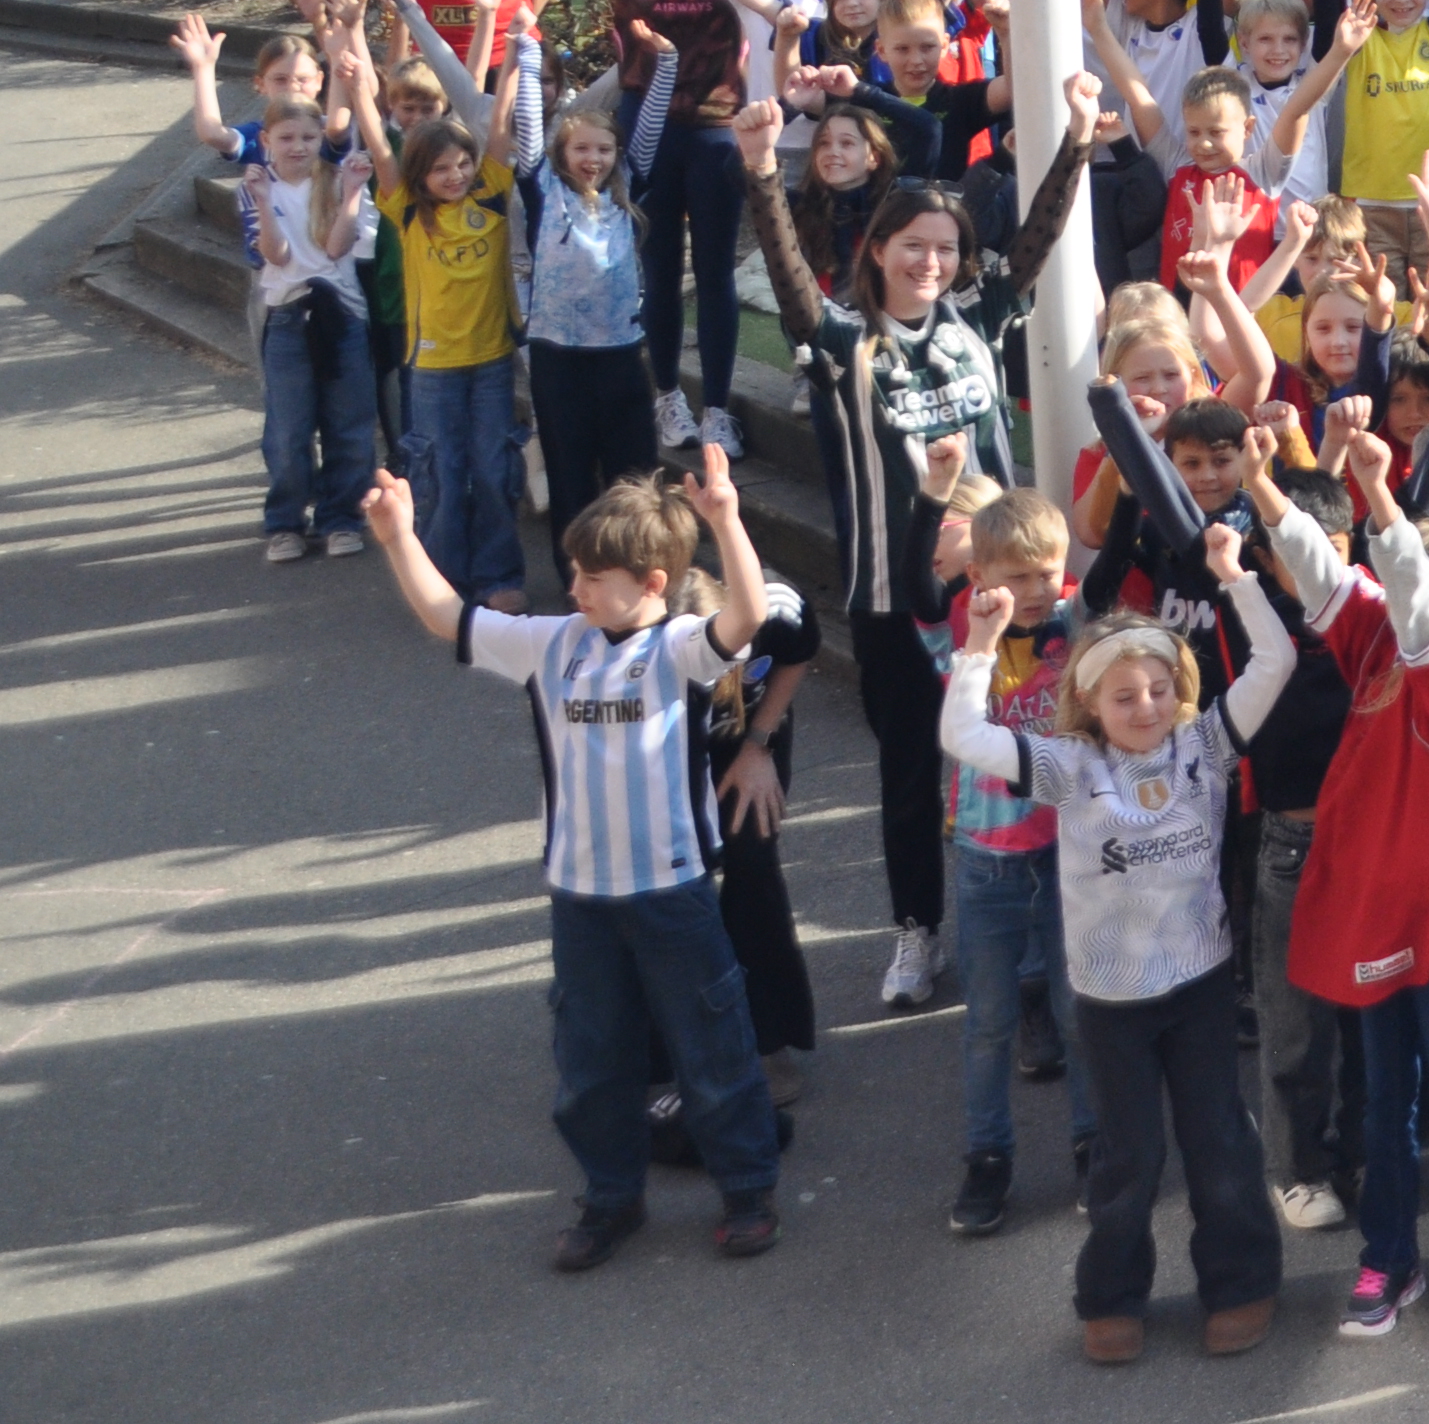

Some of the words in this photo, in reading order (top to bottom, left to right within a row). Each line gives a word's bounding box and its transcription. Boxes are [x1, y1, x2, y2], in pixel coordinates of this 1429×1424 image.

[653, 2, 713, 12] AIRWAYS
[889, 381, 960, 412] Team
[1128, 835, 1211, 867] chartered
